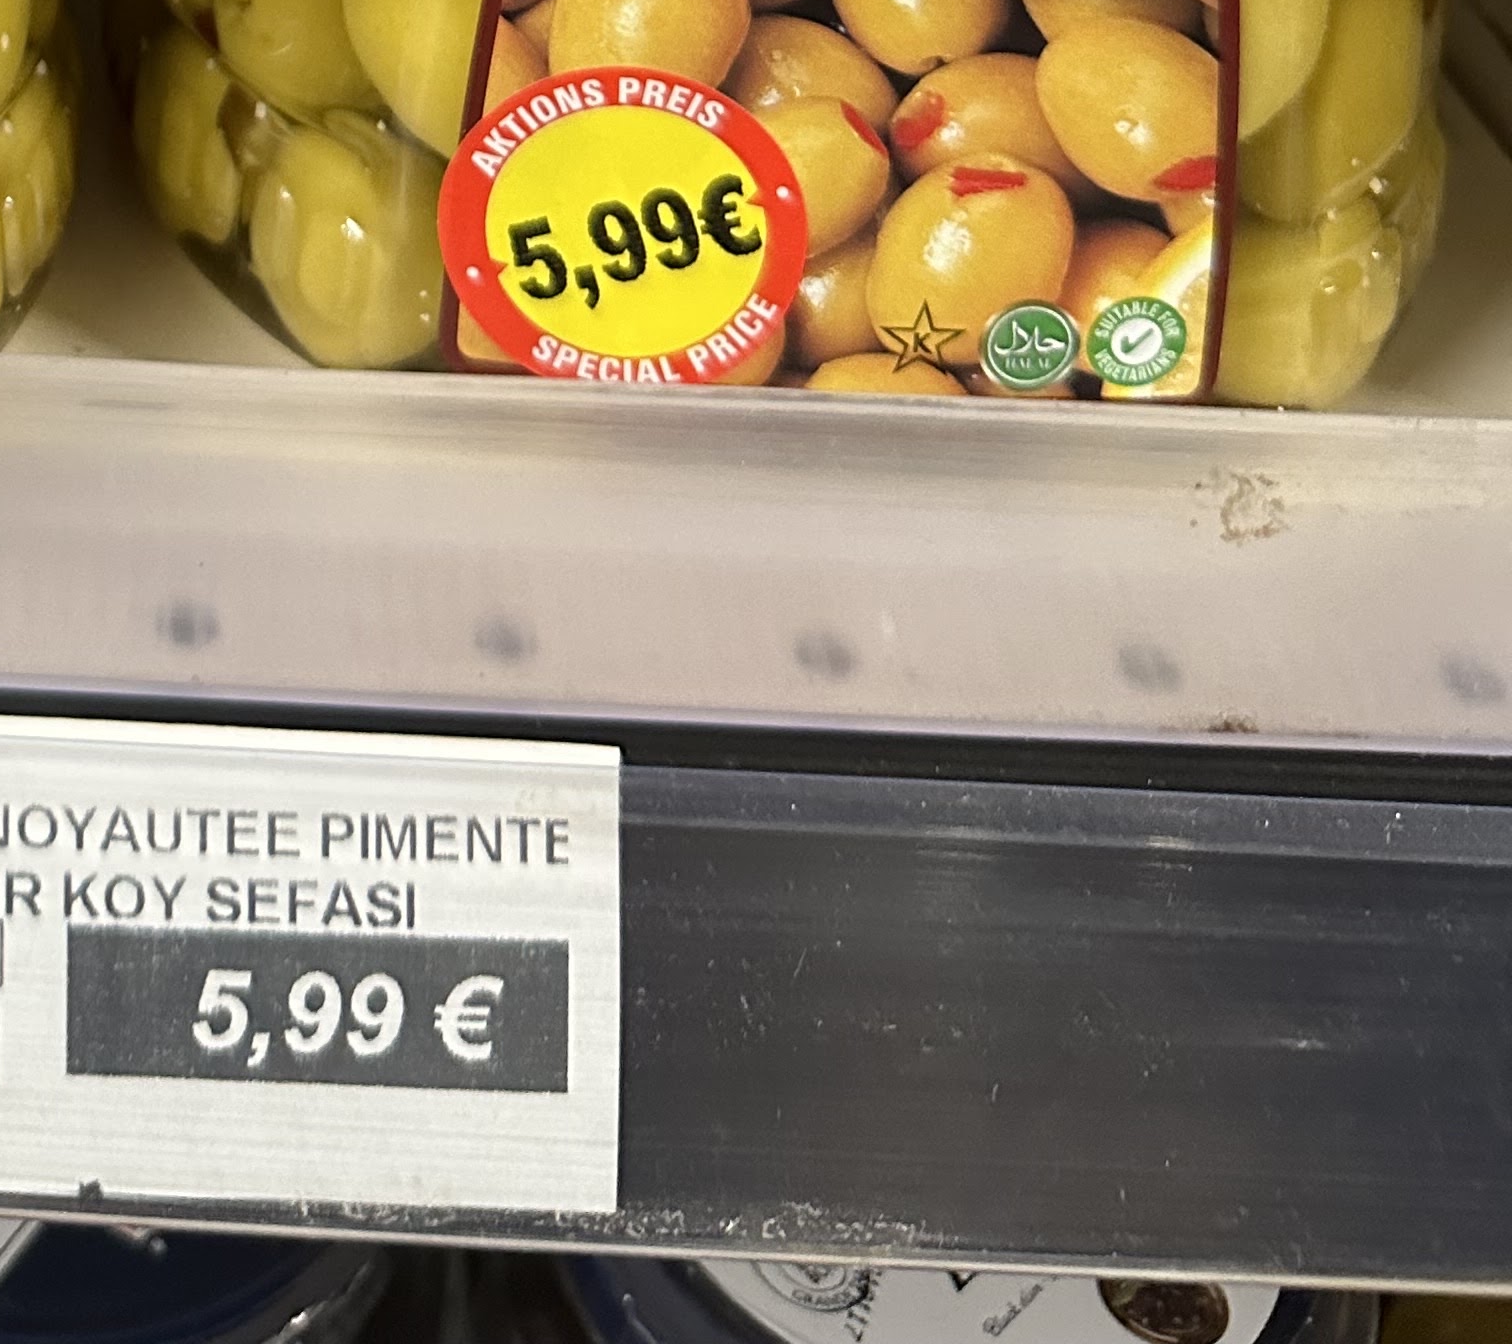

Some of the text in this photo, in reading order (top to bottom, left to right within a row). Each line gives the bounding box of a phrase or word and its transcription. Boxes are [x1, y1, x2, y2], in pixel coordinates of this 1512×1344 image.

[471, 76, 726, 179] AKTIONS PREIS
[508, 174, 763, 310] 5,99€
[531, 293, 779, 383] SPECIAL PRICE
[1094, 300, 1181, 338] SUITABLE FOR
[319, 813, 570, 867] PIMENTE
[63, 874, 186, 924] KOY
[205, 879, 415, 930] SEFASI
[194, 967, 507, 1069] 5,99 €
